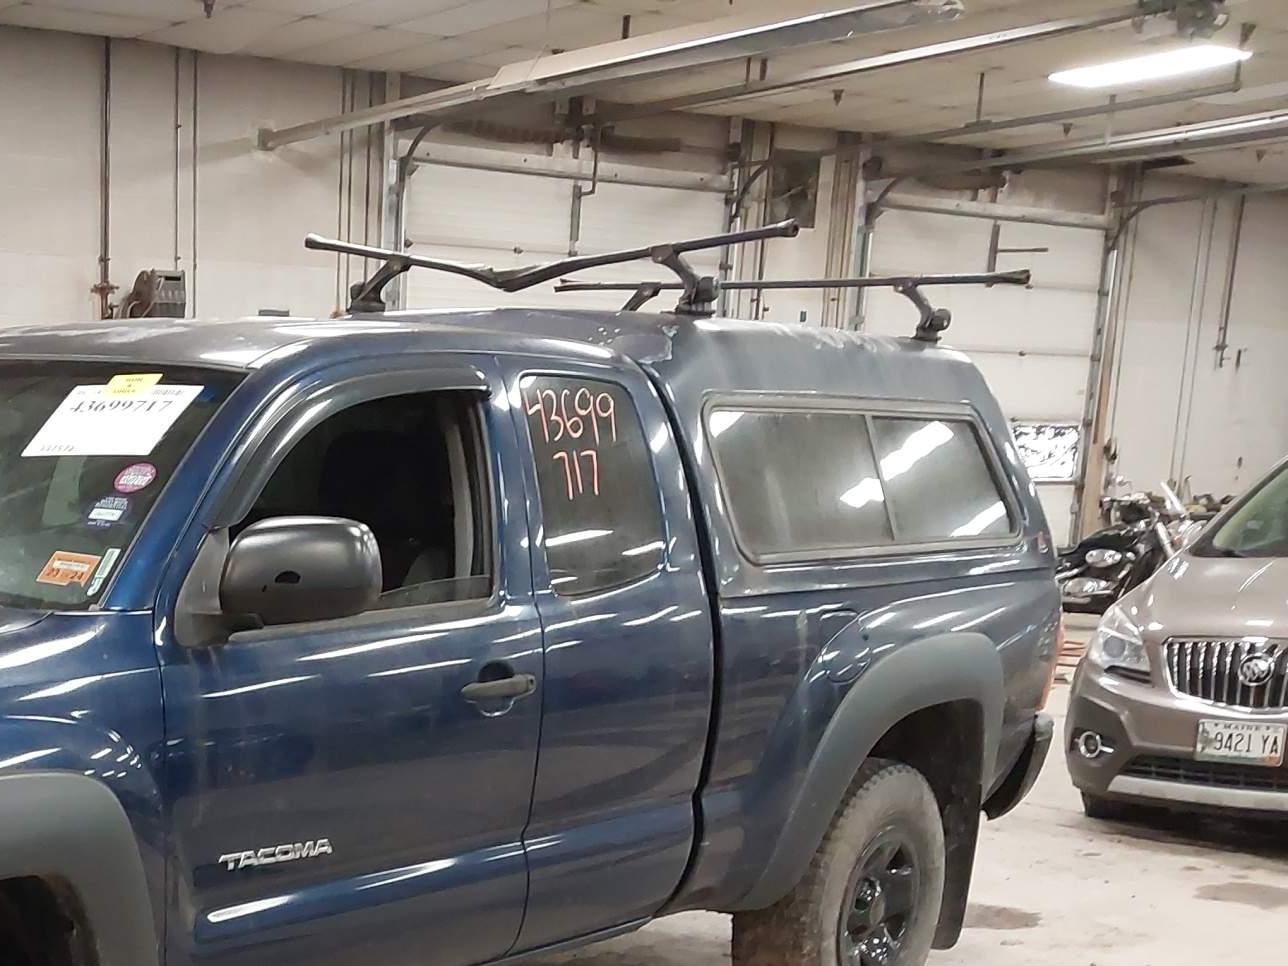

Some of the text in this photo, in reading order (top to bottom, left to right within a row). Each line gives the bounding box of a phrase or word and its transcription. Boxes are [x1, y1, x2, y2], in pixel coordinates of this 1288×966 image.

[70, 400, 174, 413] 43699717
[523, 387, 617, 446] 43699
[552, 449, 600, 501] 717
[1213, 731, 1279, 754] 9421 YA
[218, 838, 333, 871] TACOMA
